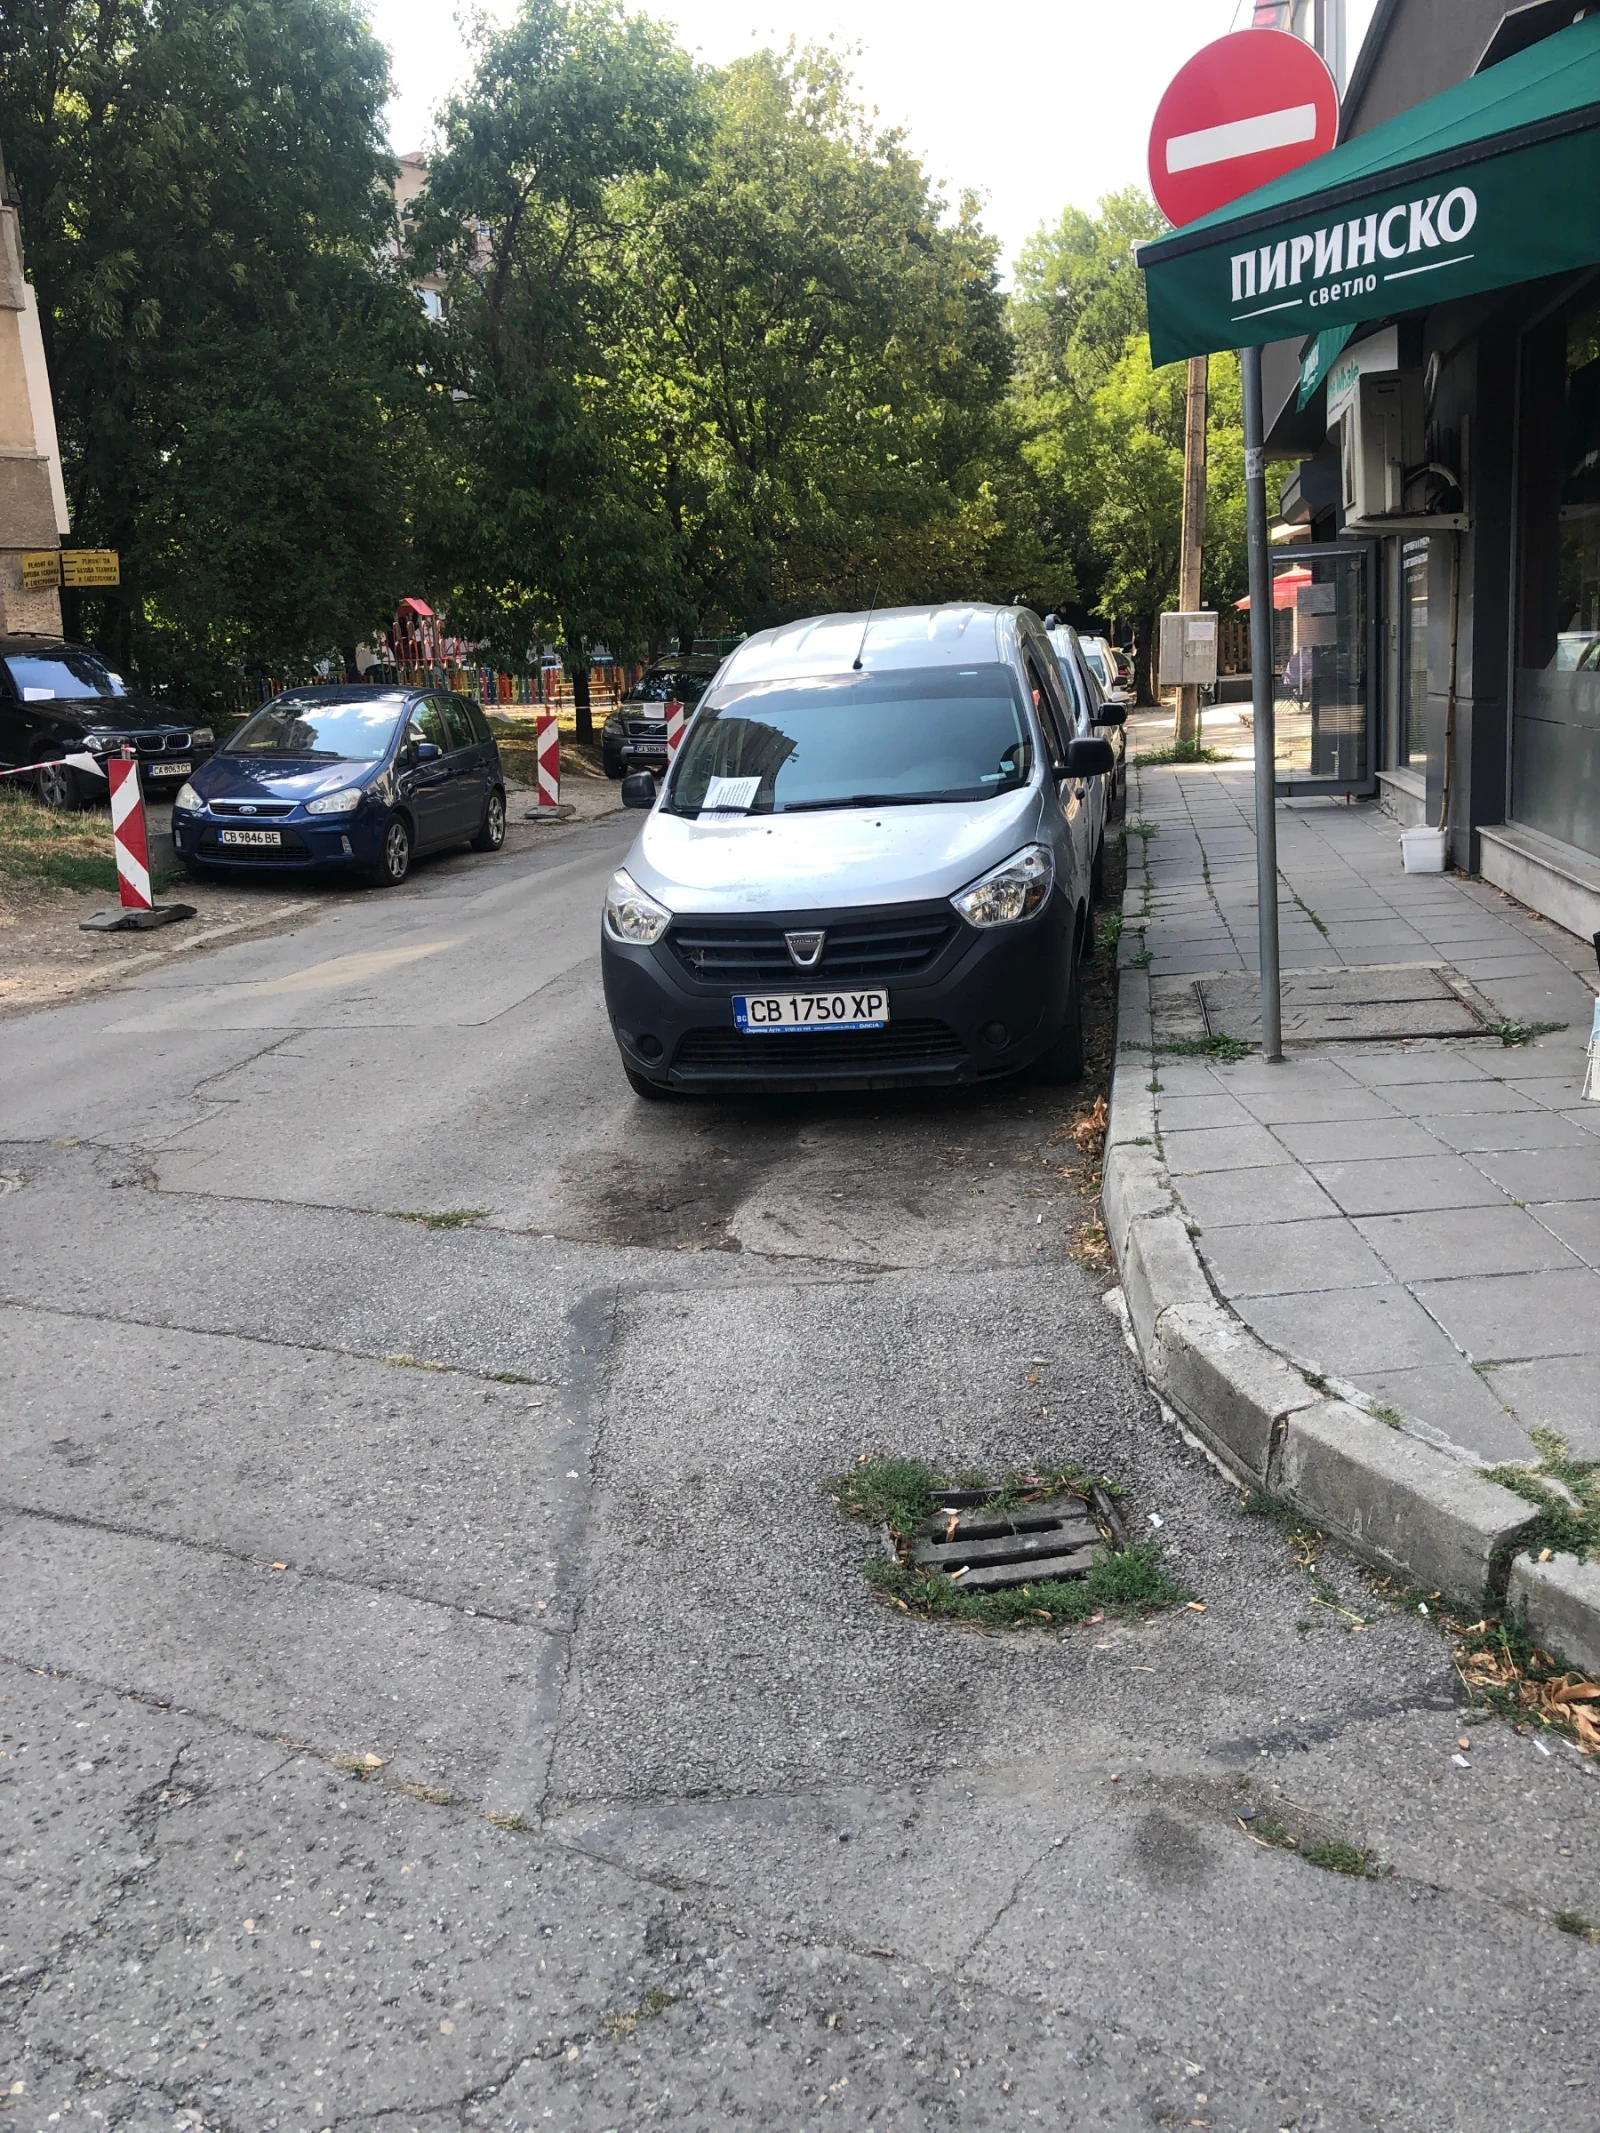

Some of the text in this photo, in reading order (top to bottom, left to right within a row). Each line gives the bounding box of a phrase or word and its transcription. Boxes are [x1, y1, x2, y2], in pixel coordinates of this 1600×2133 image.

[1230, 186, 1478, 302] ПИРИНСКО
[1308, 273, 1377, 307] светло
[238, 832, 264, 843] 9846
[789, 996, 846, 1022] 1750
